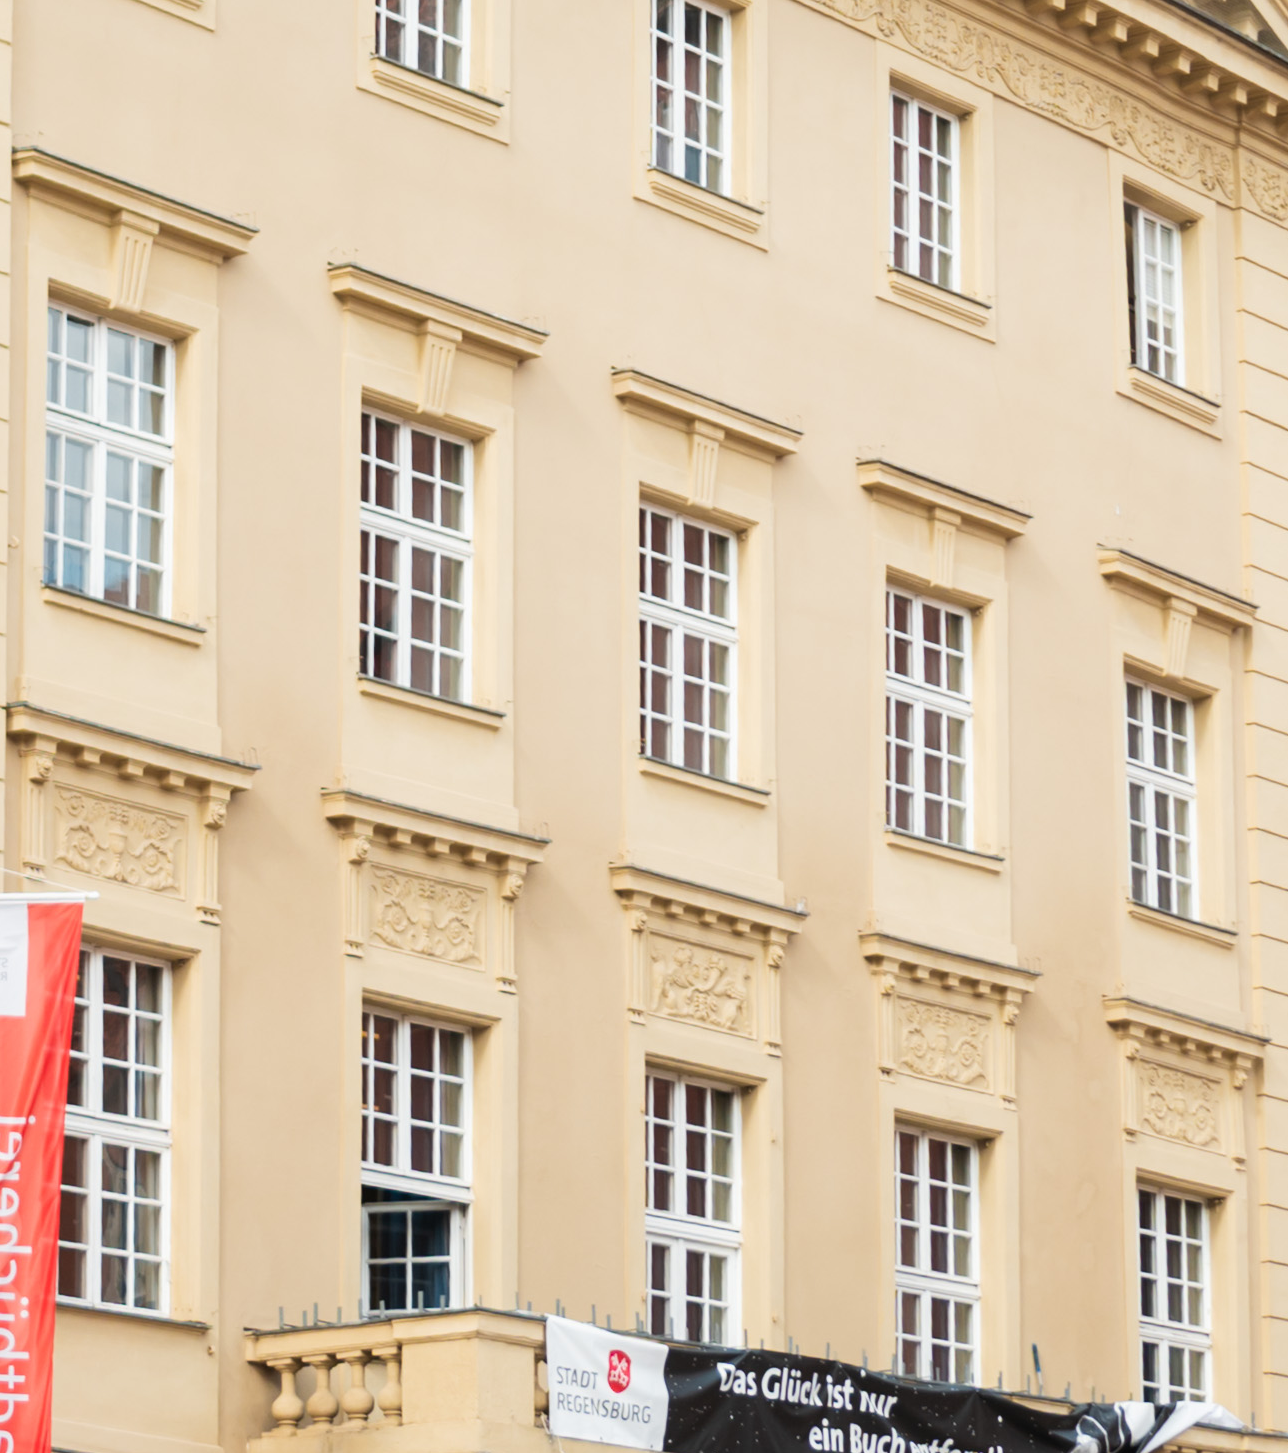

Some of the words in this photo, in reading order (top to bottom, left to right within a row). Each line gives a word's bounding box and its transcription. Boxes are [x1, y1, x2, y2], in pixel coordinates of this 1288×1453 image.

[556, 1366, 598, 1390] STADT
[717, 1362, 757, 1396] Das
[762, 1367, 823, 1407] Glück
[826, 1374, 854, 1411] ist
[860, 1389, 898, 1418] nur
[557, 1392, 651, 1424] REGENSBURG
[809, 1418, 844, 1453] ein
